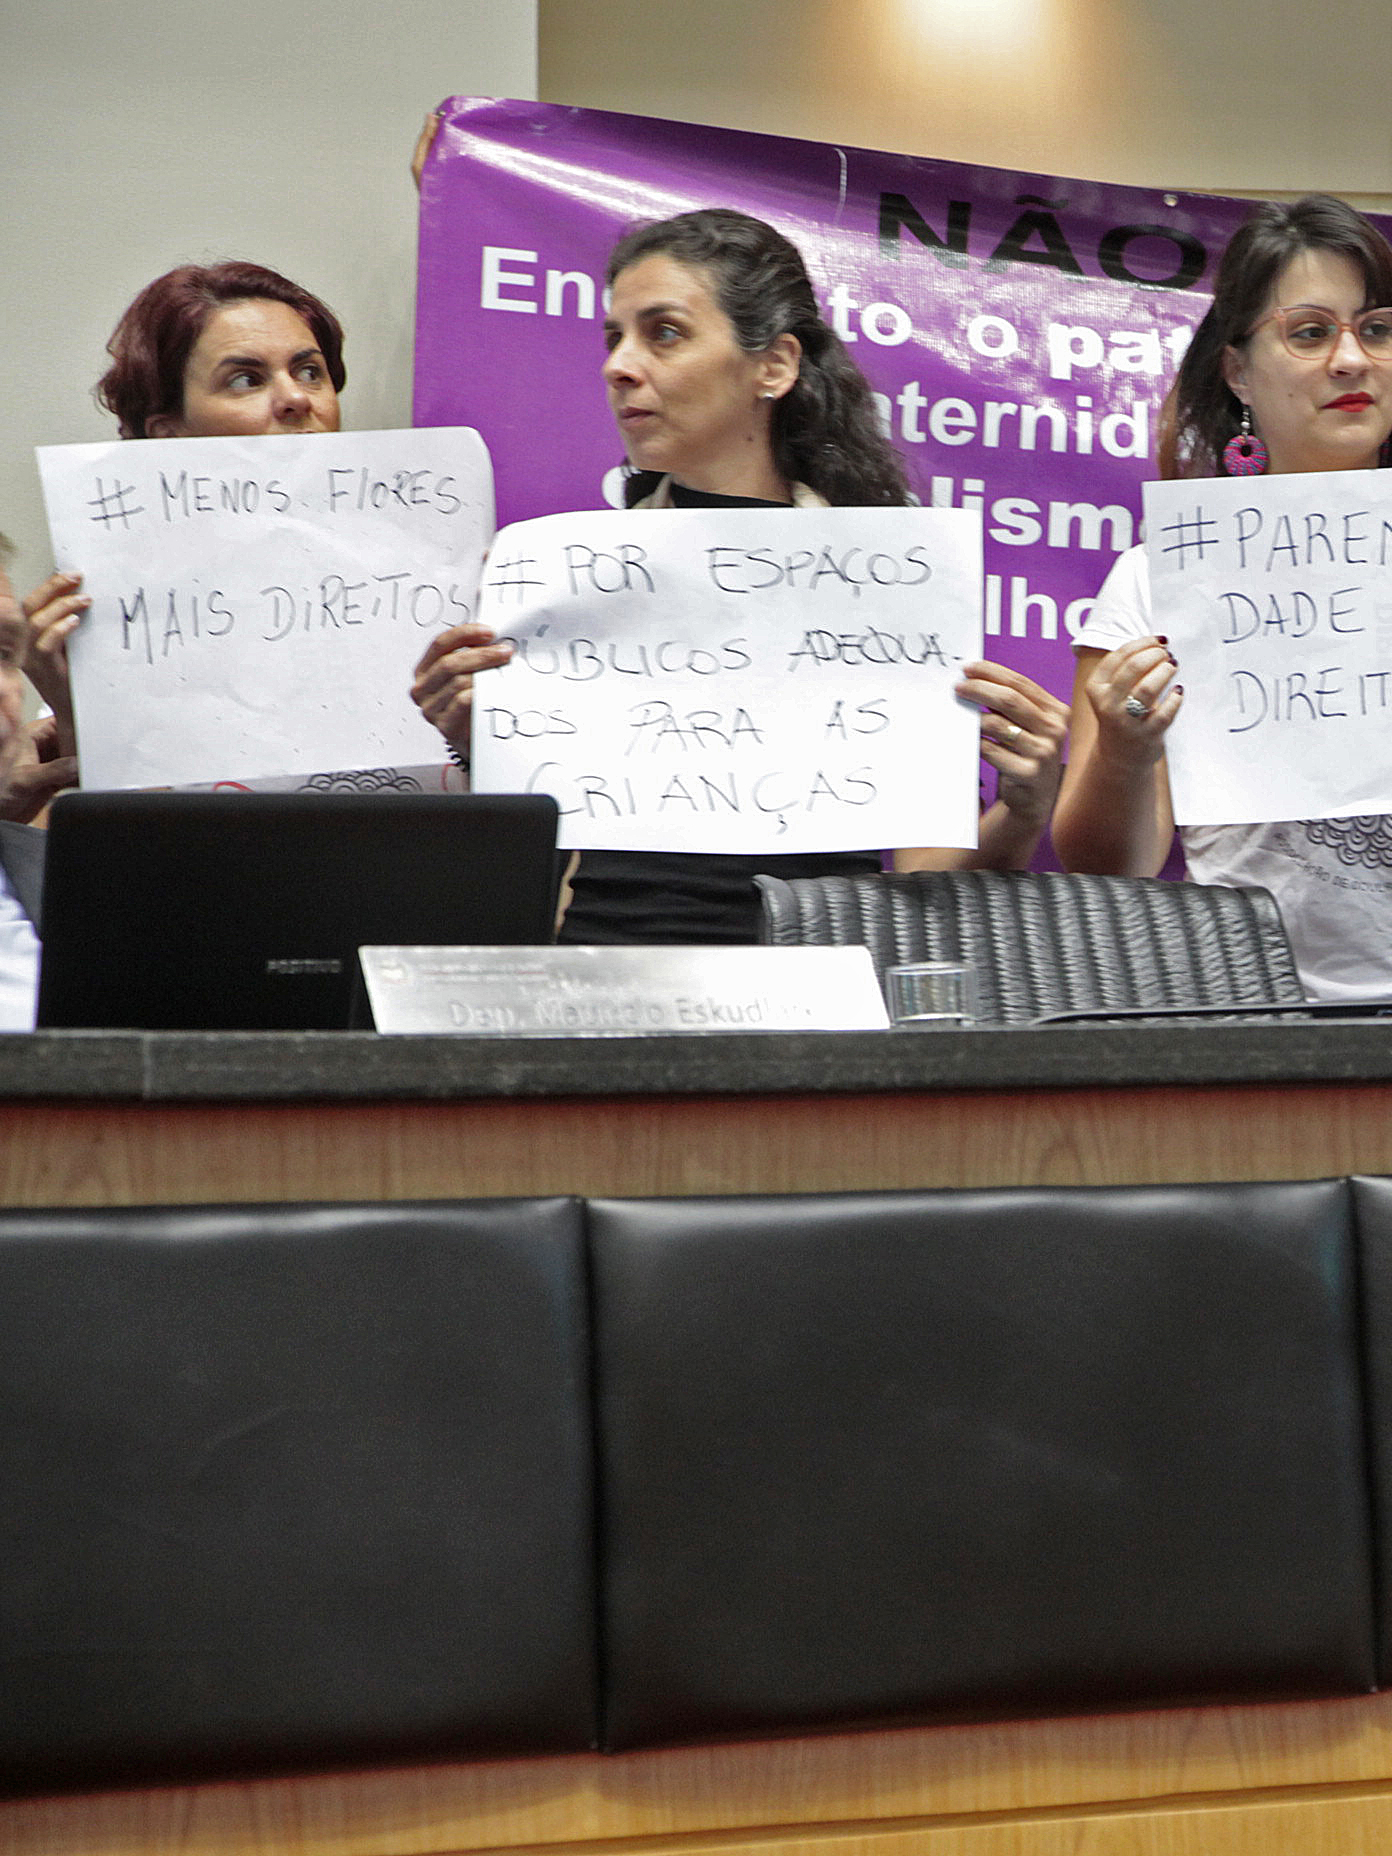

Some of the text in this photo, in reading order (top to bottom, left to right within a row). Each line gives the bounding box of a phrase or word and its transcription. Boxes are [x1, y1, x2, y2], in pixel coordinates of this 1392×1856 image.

[877, 191, 1208, 289] NÃO
[966, 314, 1019, 359] o
[703, 544, 933, 599] ESPAÇOS
[1219, 586, 1367, 645] DADE
[482, 697, 890, 757] DOS PARA AS
[524, 761, 877, 835] CRIANÇAS
